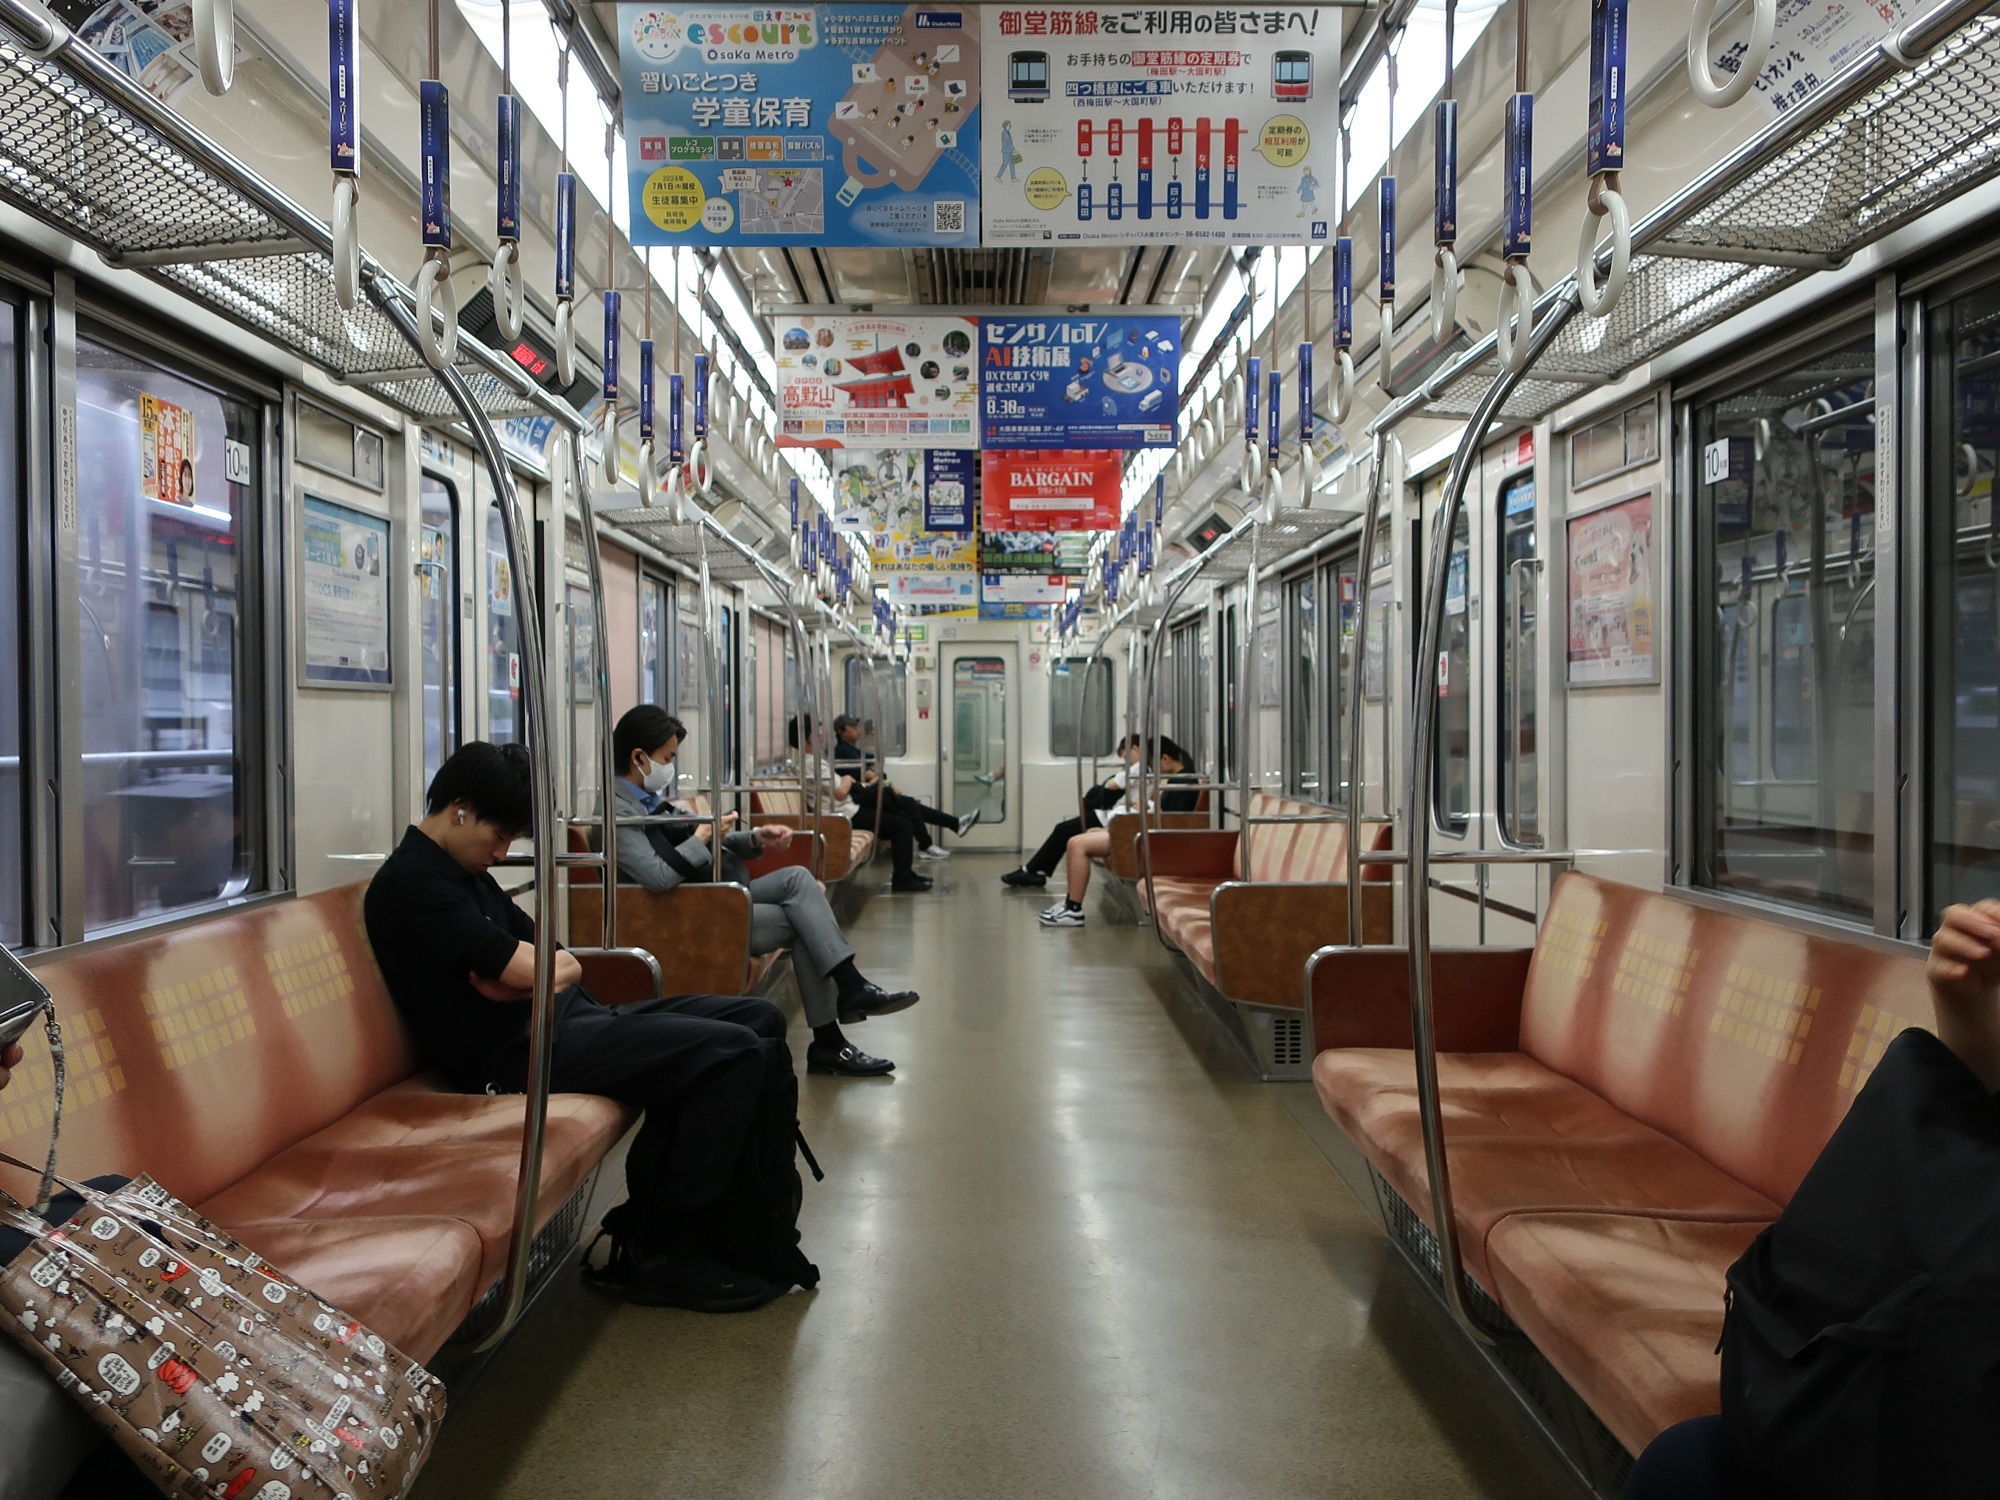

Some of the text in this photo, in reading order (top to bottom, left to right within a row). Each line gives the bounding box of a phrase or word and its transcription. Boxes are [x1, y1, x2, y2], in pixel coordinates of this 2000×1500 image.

[999, 8, 1318, 36] 御堂筋線をご利用の皆さまへ!
[687, 23, 812, 44] escourt
[756, 50, 794, 60] Metro
[1066, 52, 1252, 67] お手持ちの御堂筋線の定期券で
[1754, 50, 1805, 91] ヒトオシを
[640, 72, 758, 92] 習いごとつき
[1066, 80, 1254, 95] 四つ橋線にご乗車いただけます!
[692, 96, 812, 128] 学童保育
[1081, 124, 1089, 151] 梅田
[1111, 123, 1120, 151] 淀屋橋
[1170, 122, 1179, 150] 心斎橋
[1269, 126, 1302, 134] 定期券の
[644, 142, 662, 150] 英語
[1264, 137, 1306, 146] 相互利用が
[1276, 148, 1293, 157] 可能
[1140, 157, 1149, 181] 本町
[1198, 154, 1207, 181] なんば
[1227, 155, 1235, 182] 大国町
[652, 195, 698, 205] 生徒募集中
[1081, 189, 1089, 216] 西梅田
[1111, 188, 1119, 216] 肥後橋
[1170, 187, 1178, 214] 四ツ橋
[986, 346, 1070, 367] AI技術展
[986, 370, 1050, 381] DXでものづくりを
[783, 386, 835, 402] 高野山
[986, 383, 1035, 392] 進化させよう!
[163, 405, 176, 499] 本がめなく
[1010, 472, 1094, 487] BARGAIN
[874, 562, 972, 570] それはあなたの優しい気持ち
